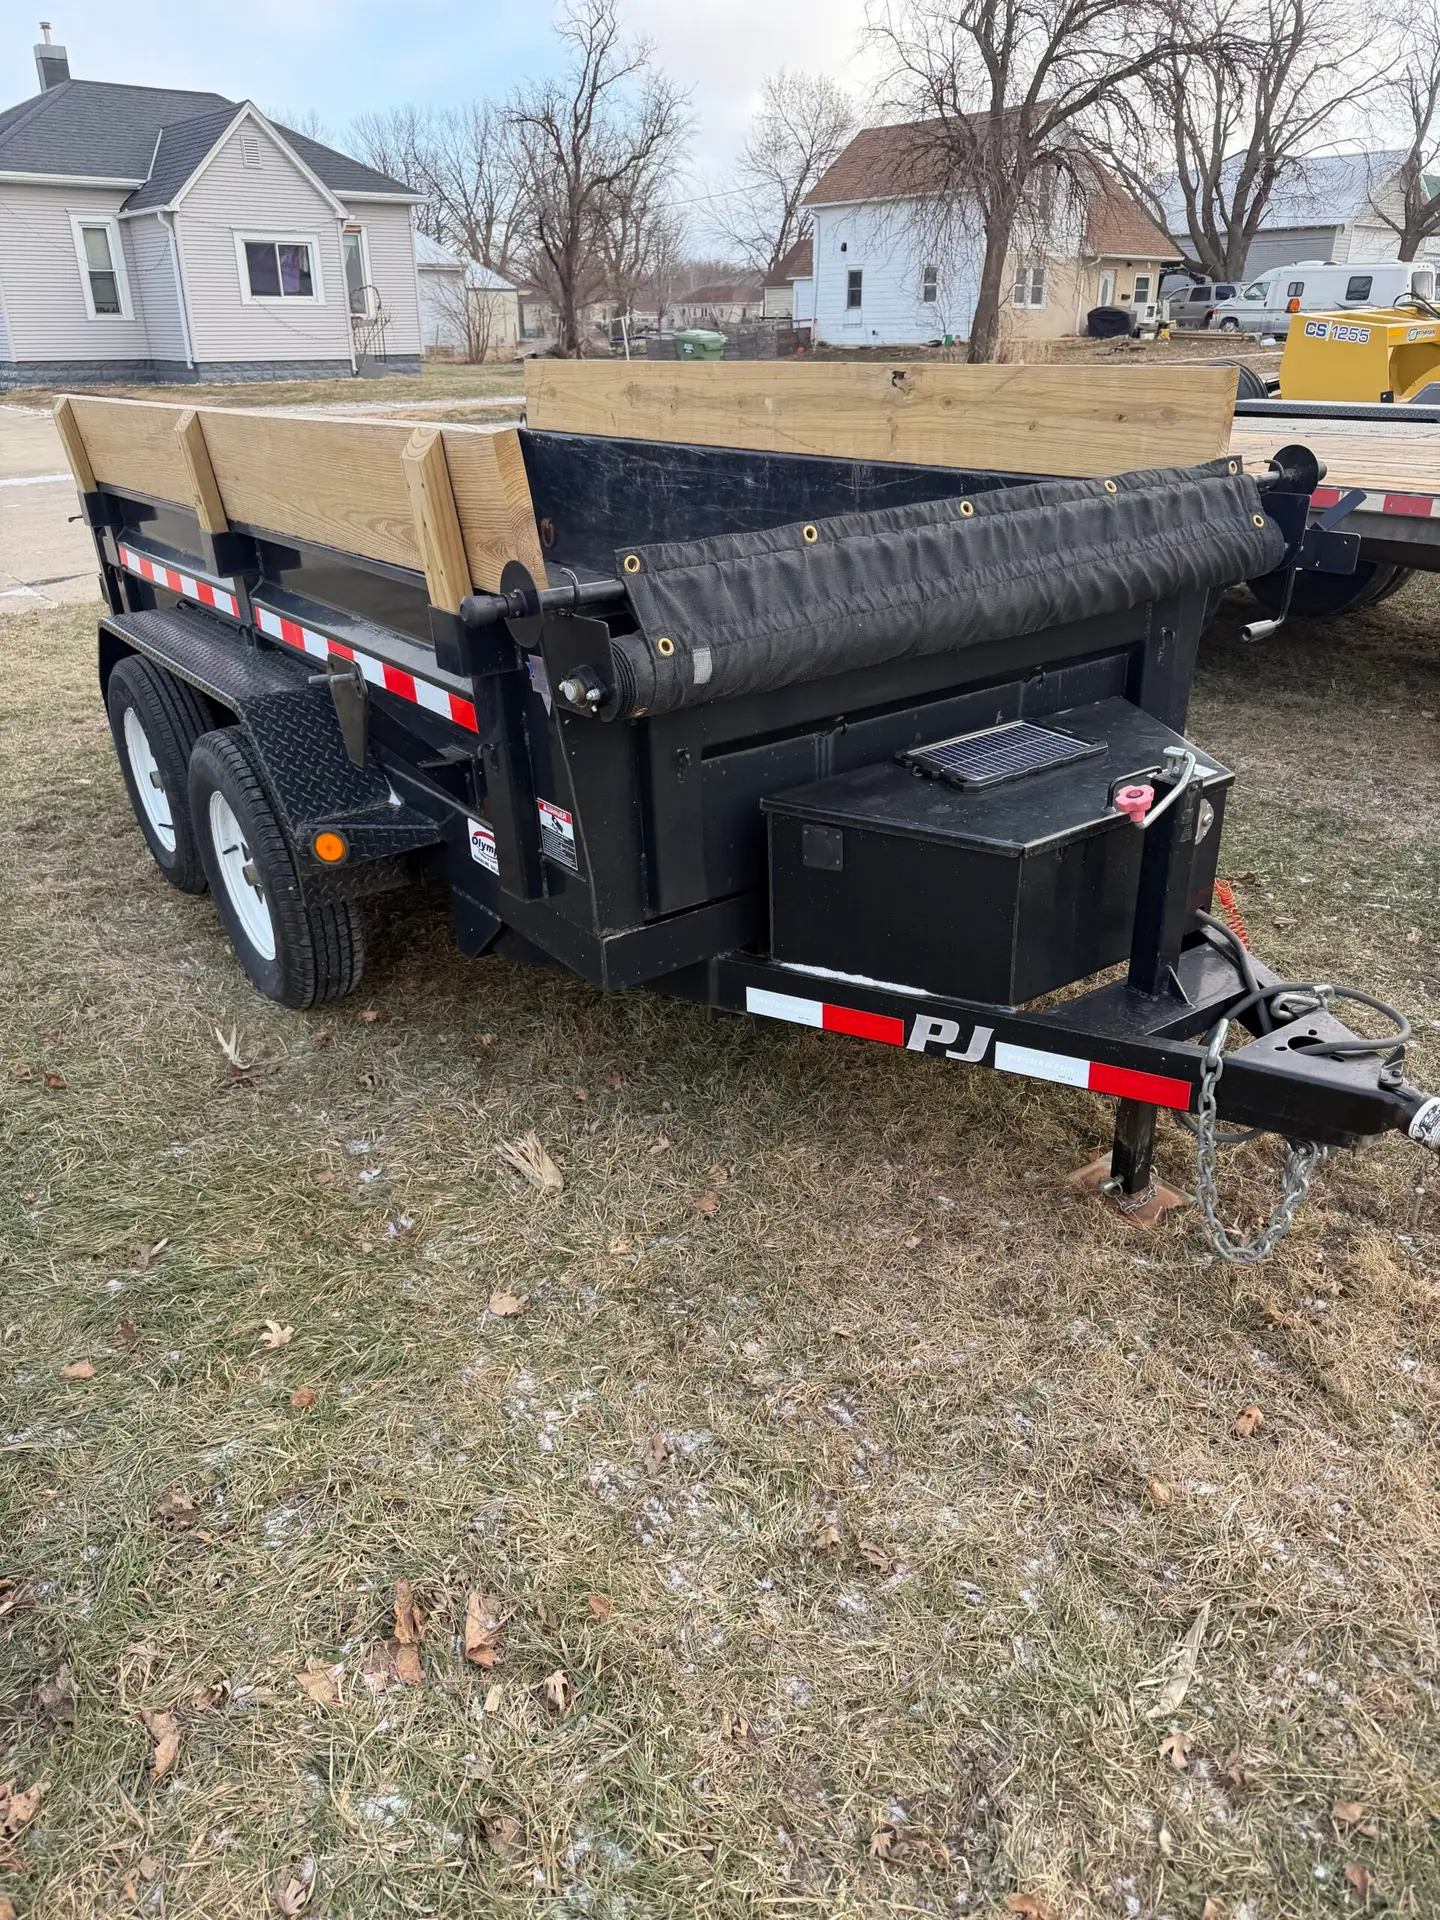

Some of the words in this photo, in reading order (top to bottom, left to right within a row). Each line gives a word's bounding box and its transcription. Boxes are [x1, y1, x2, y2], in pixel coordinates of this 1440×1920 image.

[1305, 322, 1327, 336] CS
[1331, 325, 1370, 343] 1255
[906, 1014, 994, 1062] PJ
